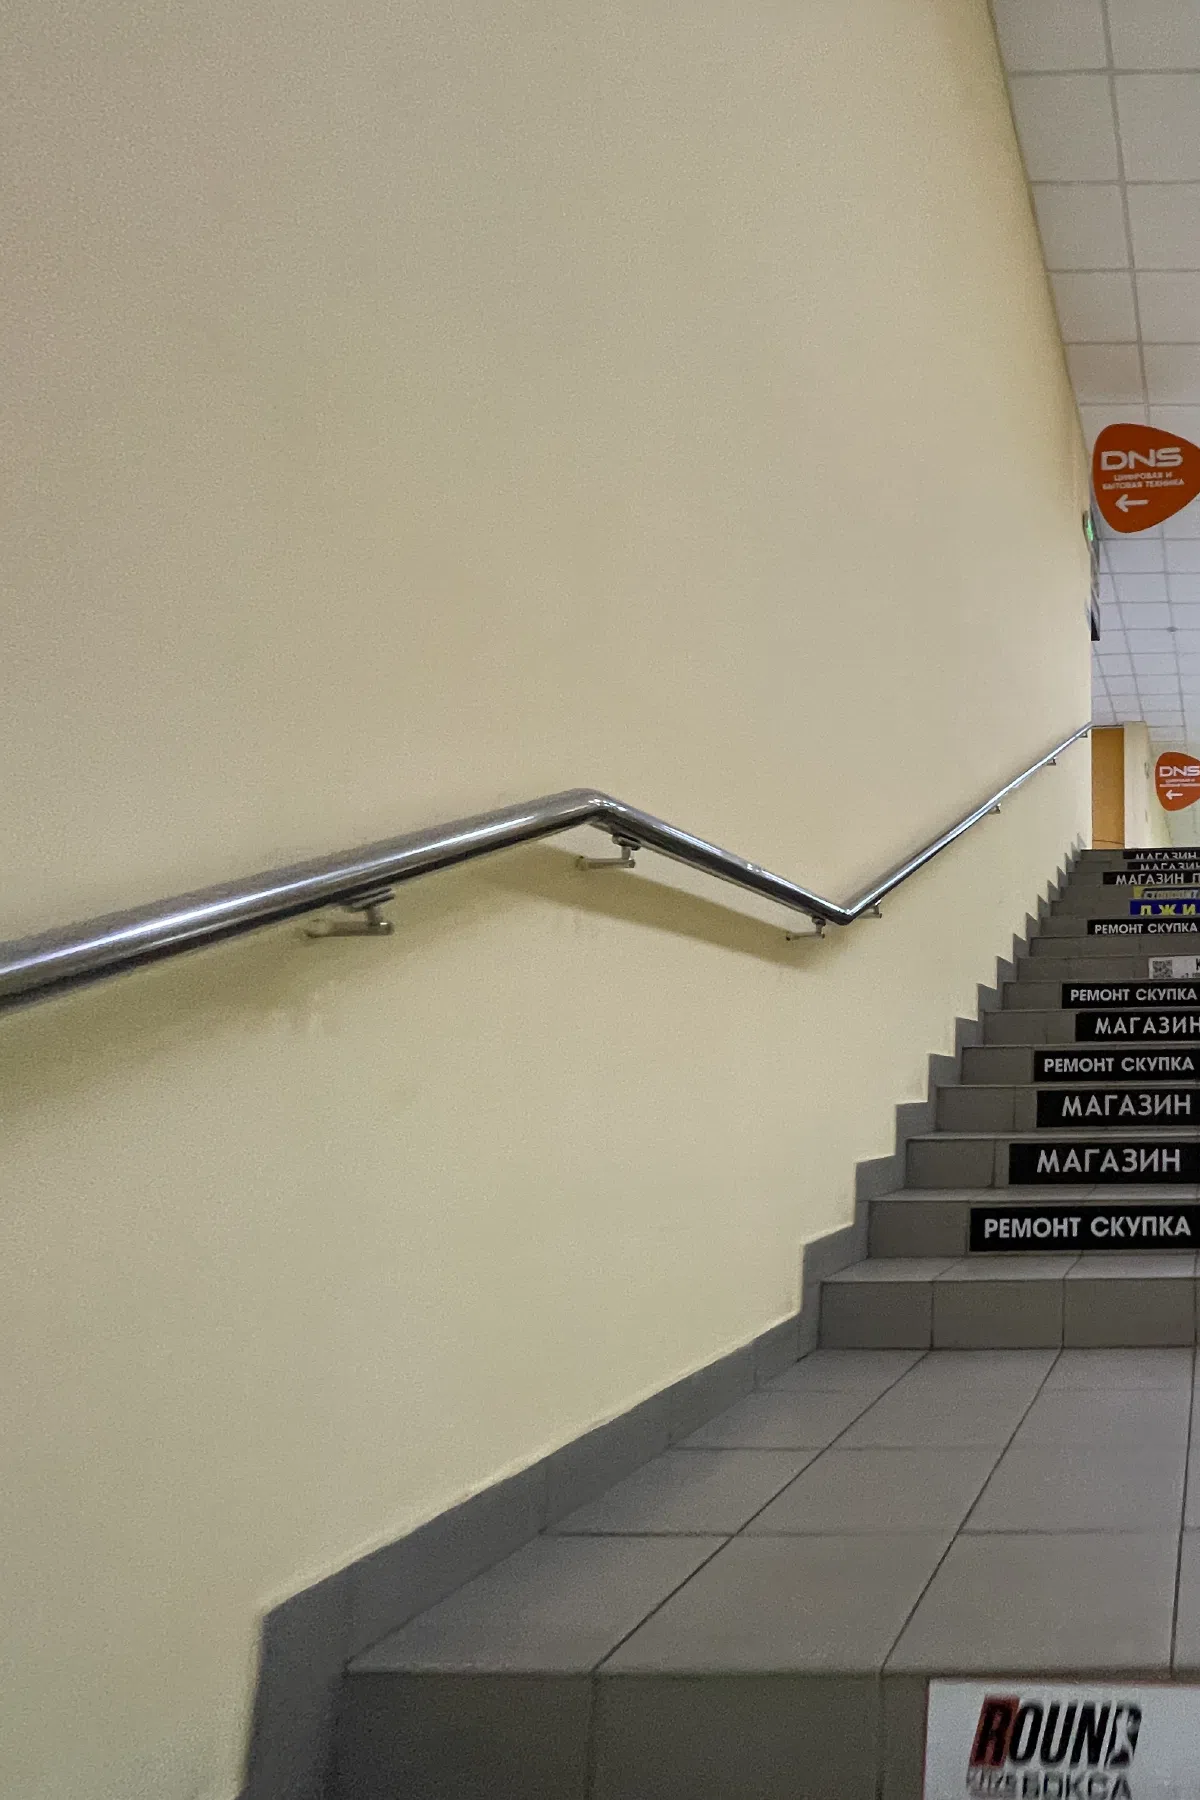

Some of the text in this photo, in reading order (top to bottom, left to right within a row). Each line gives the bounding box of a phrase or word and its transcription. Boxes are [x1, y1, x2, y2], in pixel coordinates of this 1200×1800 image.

[1101, 447, 1183, 470] DNS
[1114, 472, 1162, 480] ЦИФРОВАЯ
[1102, 478, 1185, 490] БЫТОВАЯ ТЕХНИКА
[1159, 765, 1200, 777] DNS
[1115, 873, 1184, 885] МАГАЗИН
[1094, 924, 1143, 935] РЕМОНТ
[1147, 923, 1198, 934] СКУПКА
[1070, 987, 1198, 1002] РЕМОНТ СКУПКА
[1044, 1056, 1195, 1073] РЕМОНТ СКУПКА
[1061, 1094, 1192, 1117] МАГАЗИН
[1036, 1148, 1181, 1173] МАГАЗИН
[984, 1215, 1192, 1238] РЕМОНТ СКУПКА
